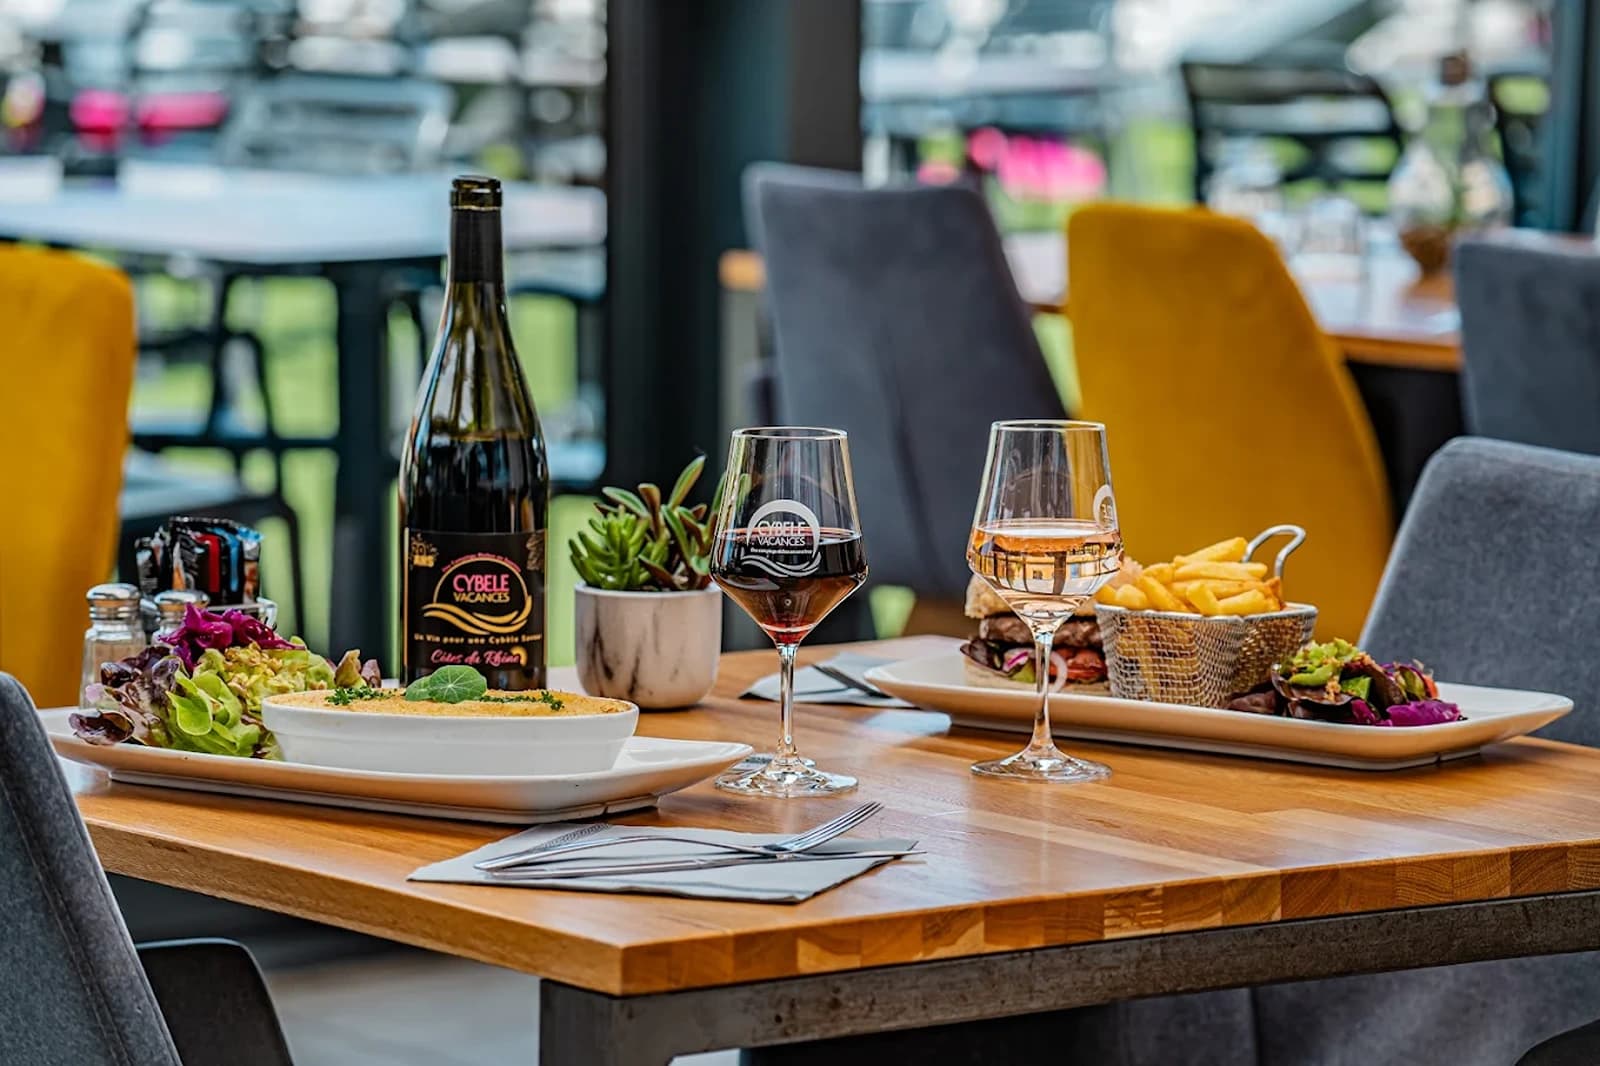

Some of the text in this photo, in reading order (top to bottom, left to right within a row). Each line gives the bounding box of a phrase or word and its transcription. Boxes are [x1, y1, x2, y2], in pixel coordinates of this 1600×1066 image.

[758, 520, 806, 536] CYBELE
[757, 536, 806, 547] VACANCES
[452, 573, 510, 592] CYBELE
[452, 591, 511, 603] VACANCES
